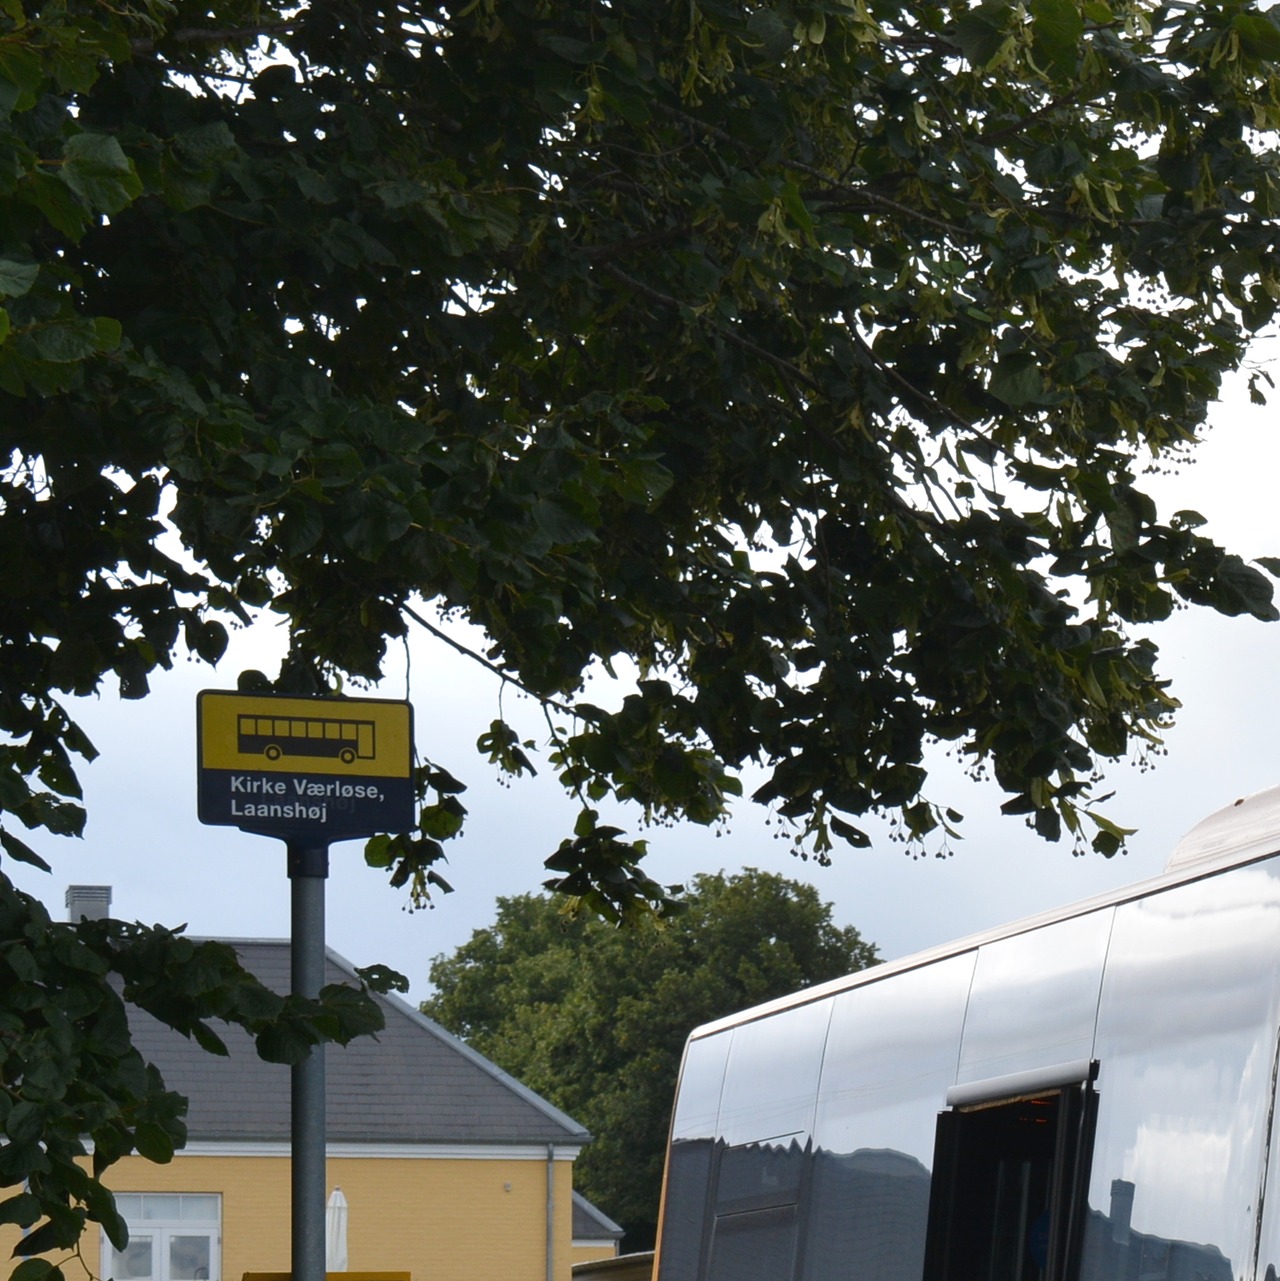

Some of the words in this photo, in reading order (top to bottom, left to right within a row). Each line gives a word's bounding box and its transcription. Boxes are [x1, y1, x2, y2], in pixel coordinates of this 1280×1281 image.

[231, 776, 287, 795] Kirke
[293, 779, 385, 802] Værløse,
[231, 799, 328, 823] Laanshøj
